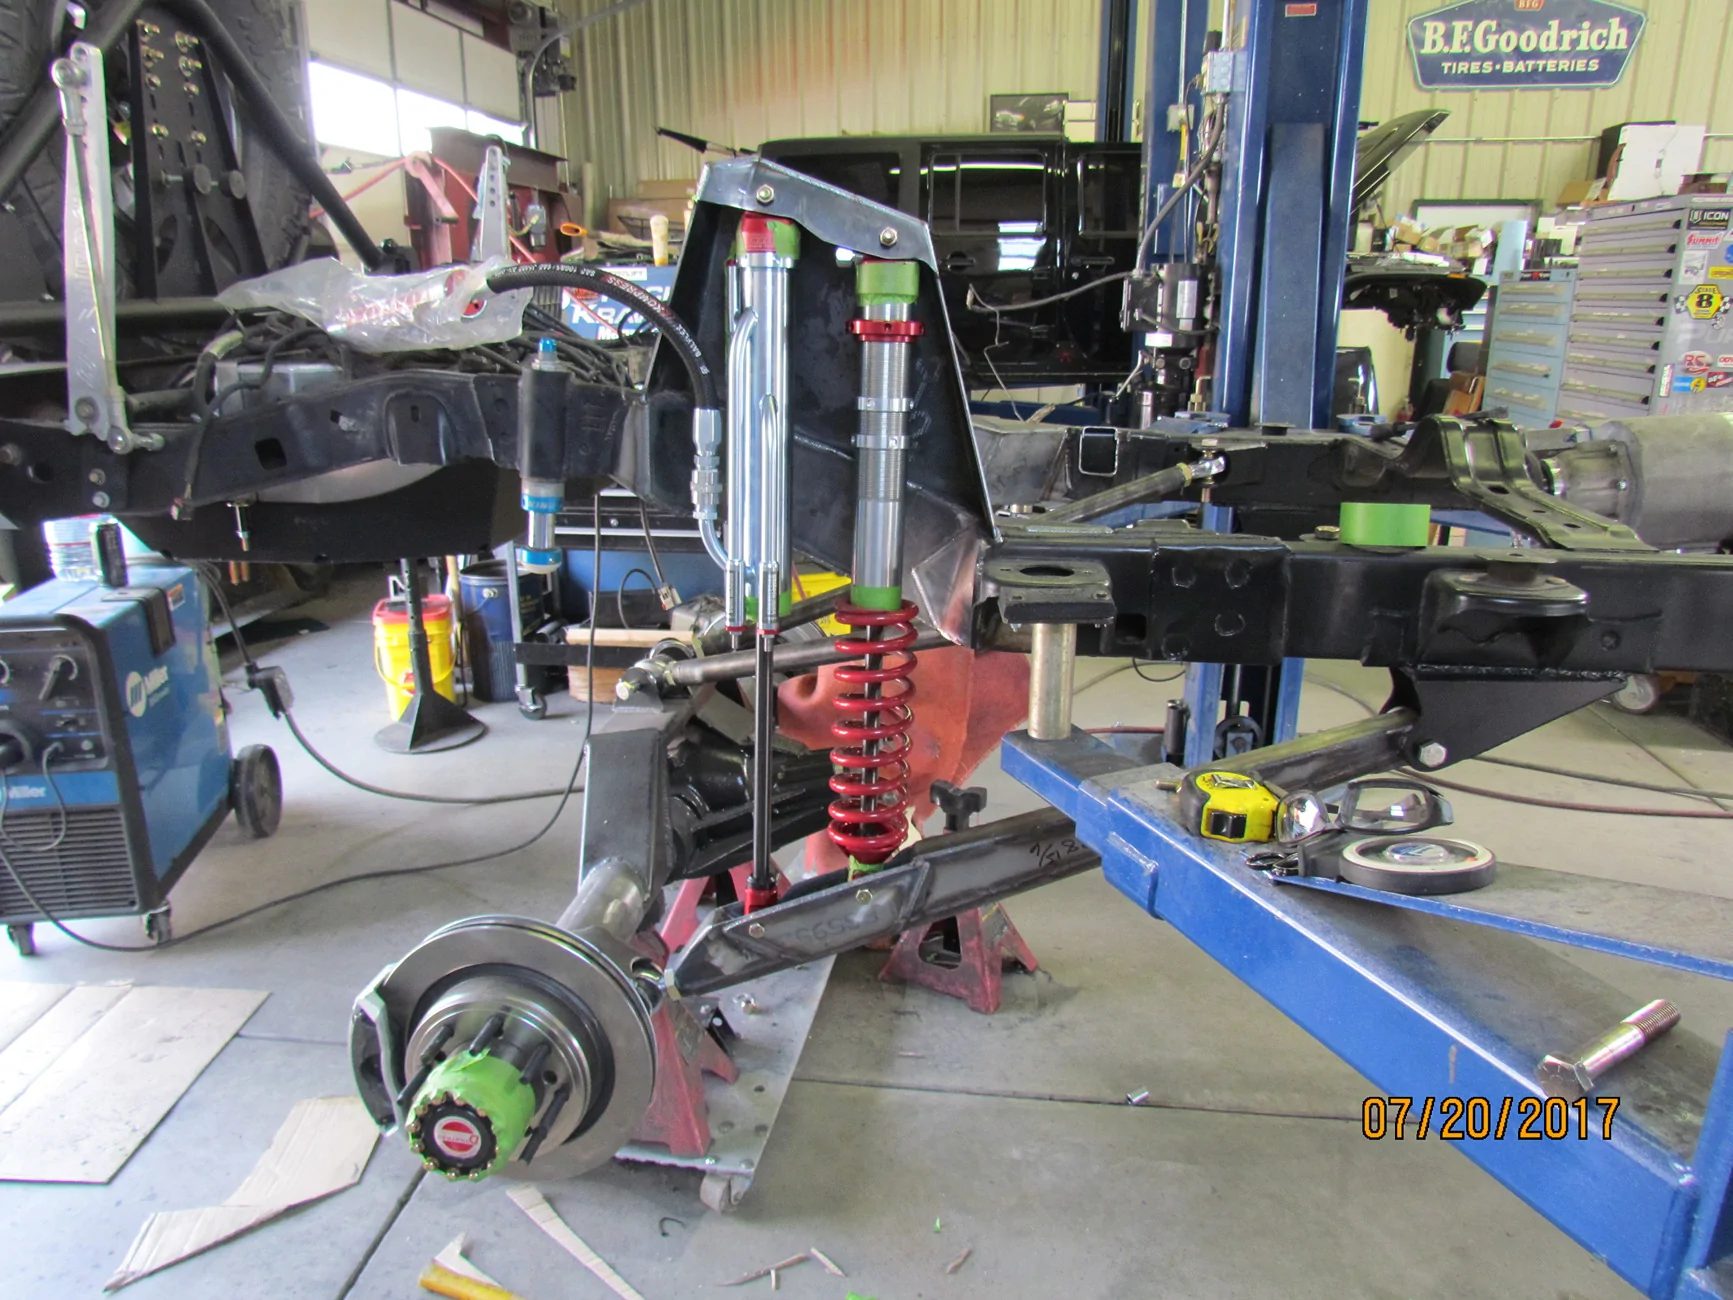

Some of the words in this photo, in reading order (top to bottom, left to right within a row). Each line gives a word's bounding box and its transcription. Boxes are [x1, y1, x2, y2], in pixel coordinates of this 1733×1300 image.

[1441, 61, 1493, 74] TIRES
[1502, 59, 1599, 73] BATTERIES
[1703, 211, 1729, 221] ICON
[1695, 293, 1714, 309] 8
